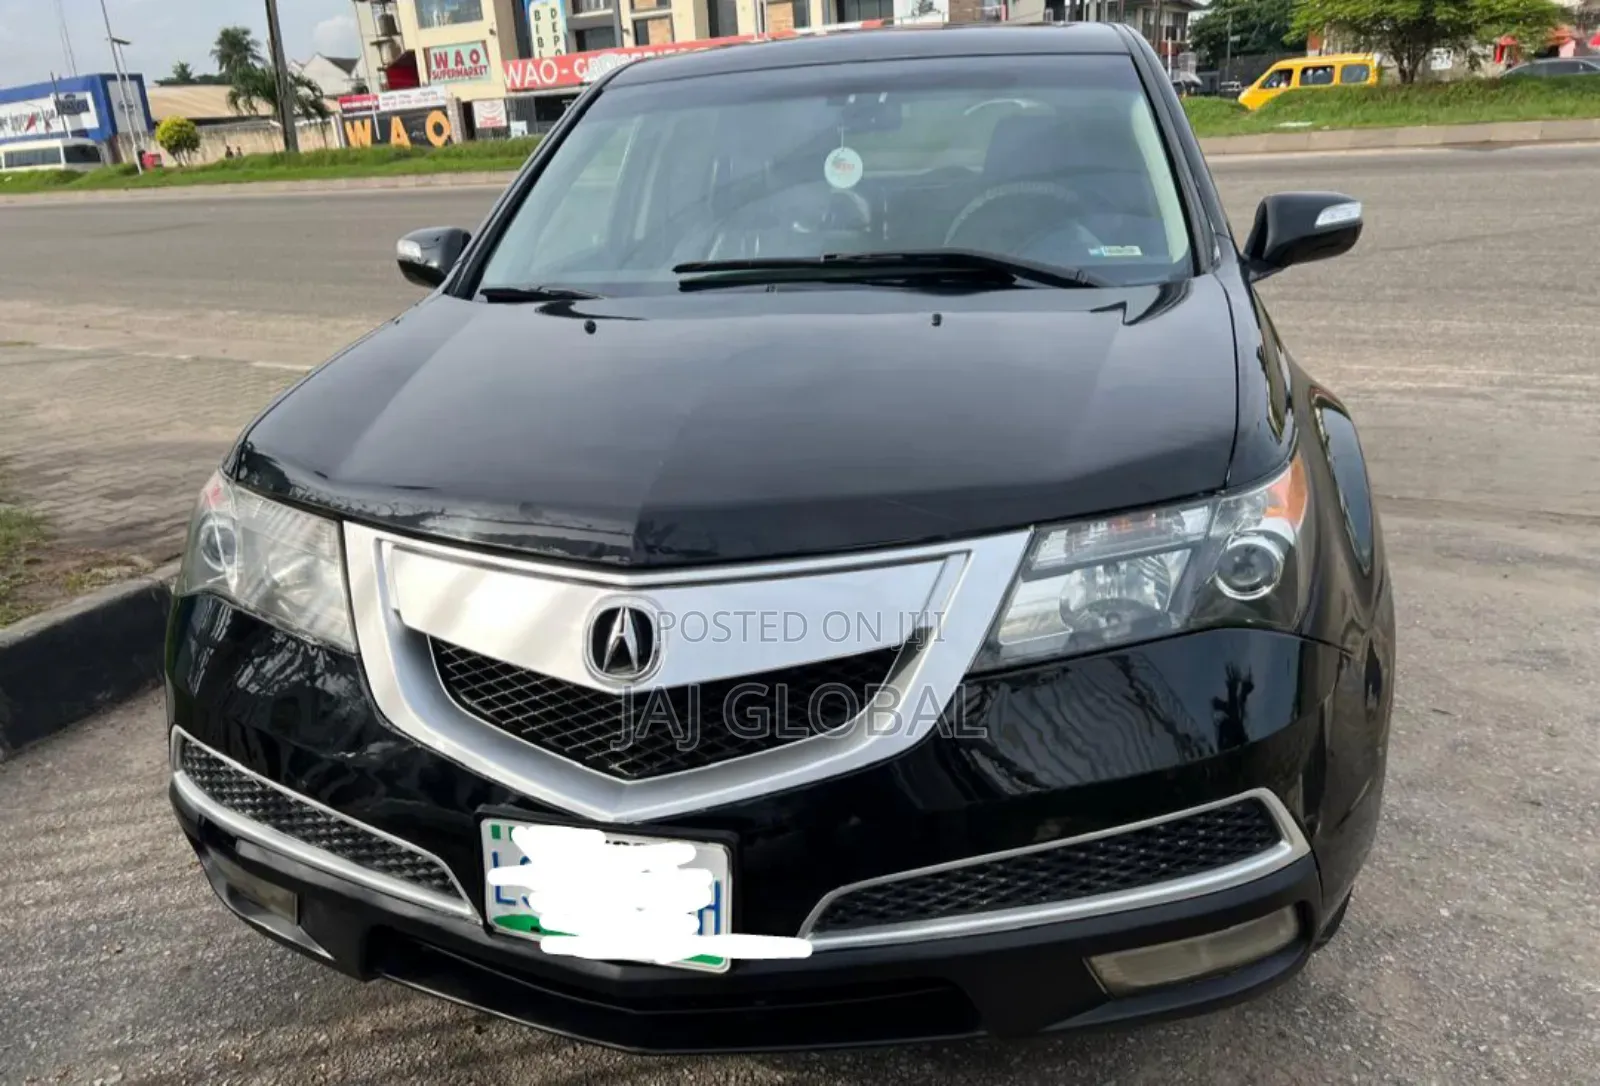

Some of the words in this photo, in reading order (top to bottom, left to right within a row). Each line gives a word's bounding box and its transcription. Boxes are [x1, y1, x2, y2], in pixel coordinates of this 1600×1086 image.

[433, 49, 481, 69] WAO
[430, 65, 488, 80] SUPERMARKET
[345, 109, 451, 148] WAO
